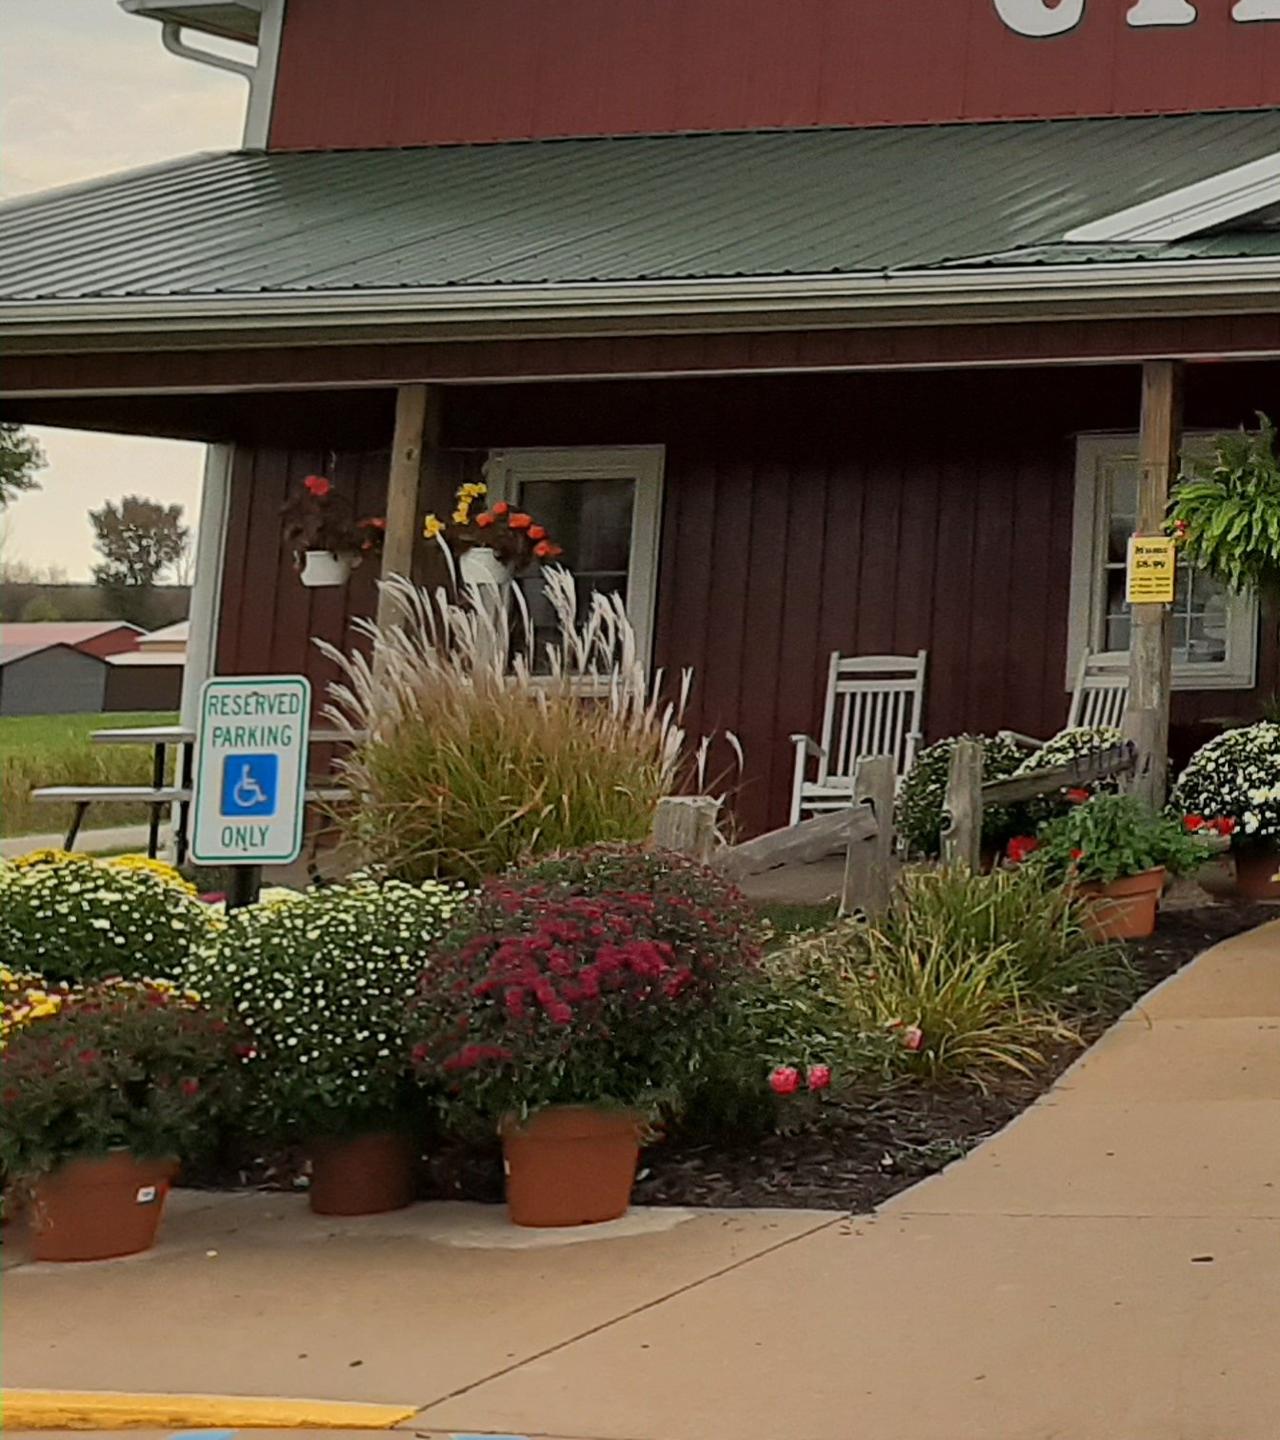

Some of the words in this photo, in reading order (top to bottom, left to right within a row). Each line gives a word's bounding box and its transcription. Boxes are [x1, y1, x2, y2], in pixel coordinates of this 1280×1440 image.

[208, 693, 300, 716] RESERVED
[212, 725, 293, 748] PARKING
[221, 825, 270, 848] ONLY
